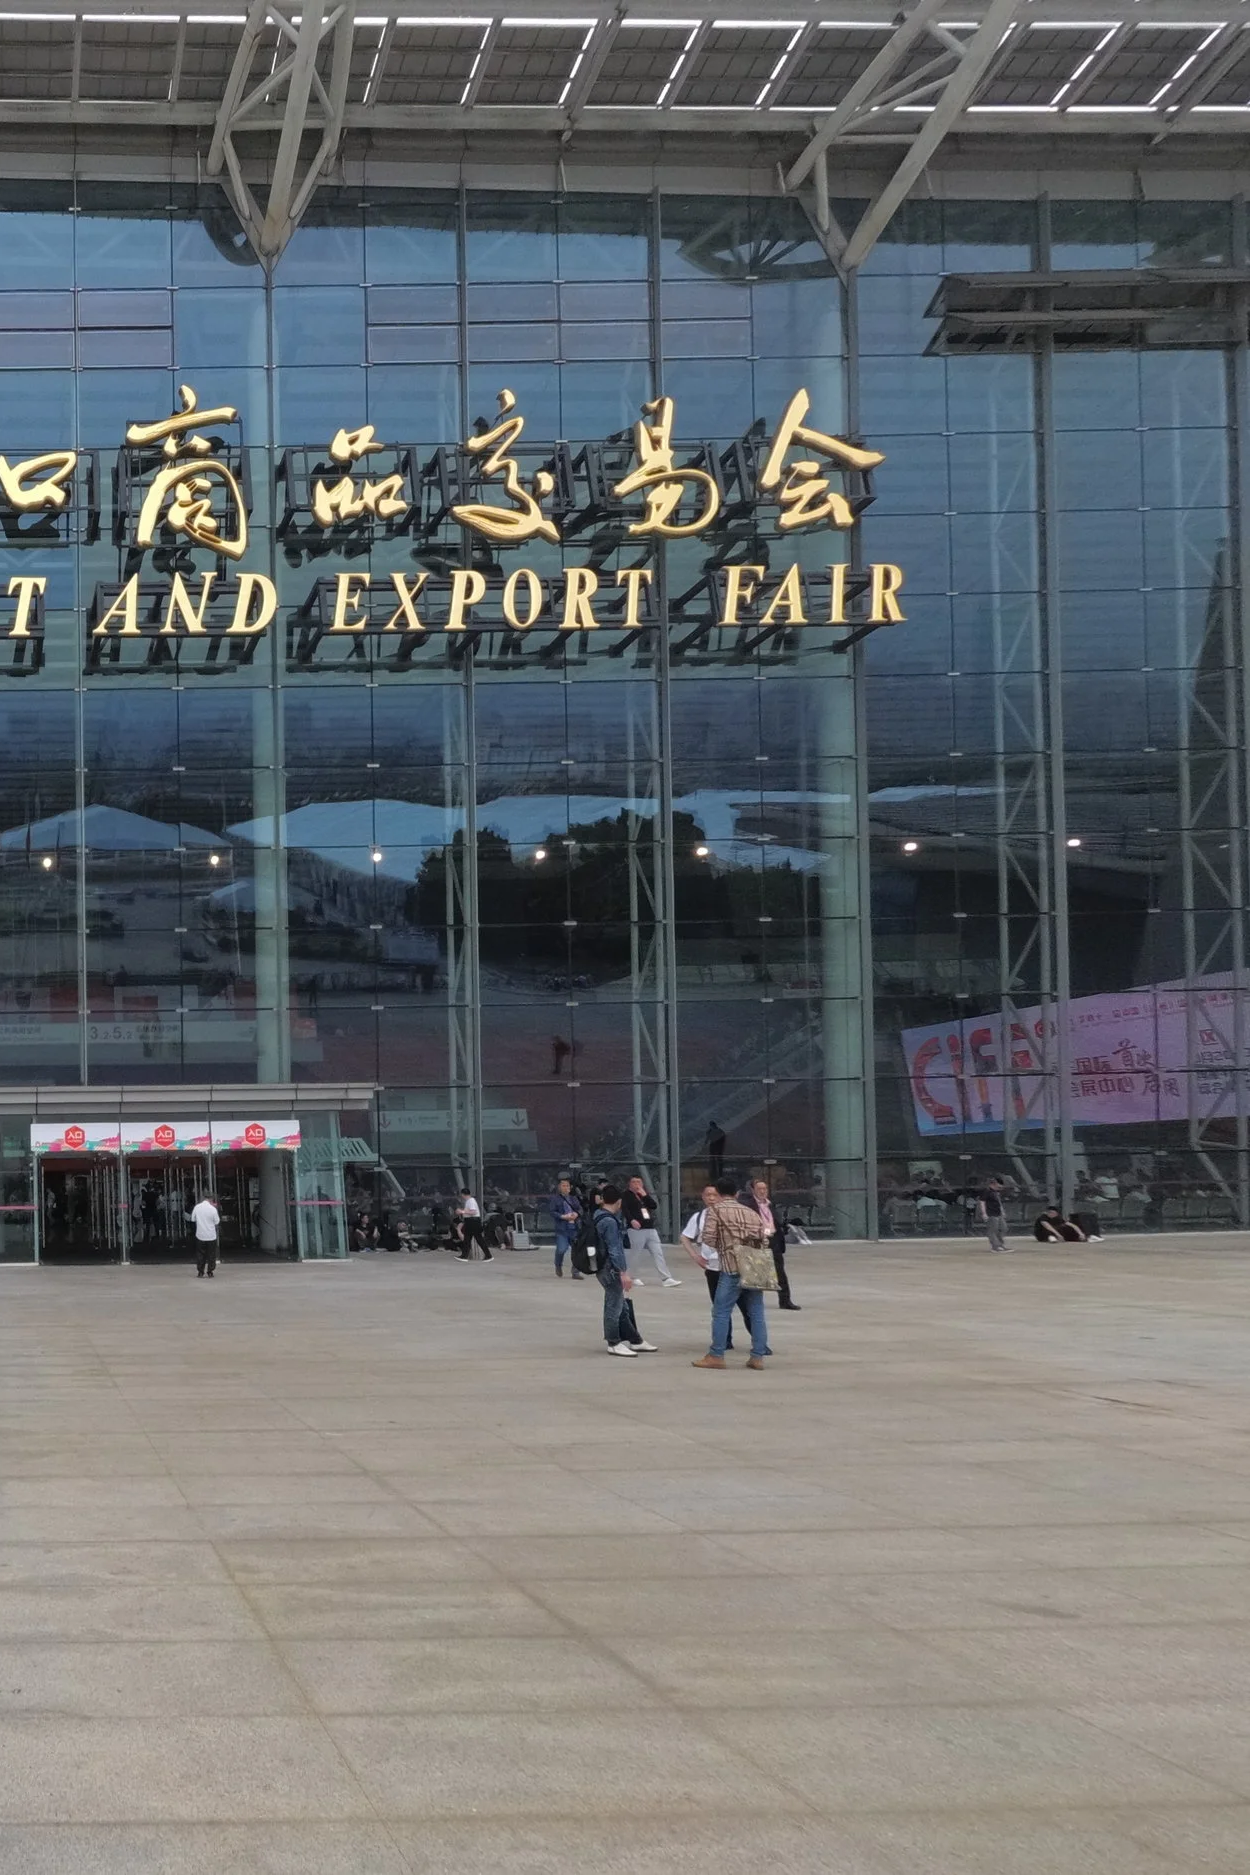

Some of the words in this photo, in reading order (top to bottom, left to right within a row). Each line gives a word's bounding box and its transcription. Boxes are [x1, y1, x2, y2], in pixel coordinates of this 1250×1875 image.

[92, 571, 279, 635] AND
[329, 567, 654, 631] EXPORT
[719, 563, 905, 626] FAIR
[66, 1130, 83, 1139] 入口
[157, 1130, 173, 1138] 入口
[248, 1128, 263, 1137] 入口
